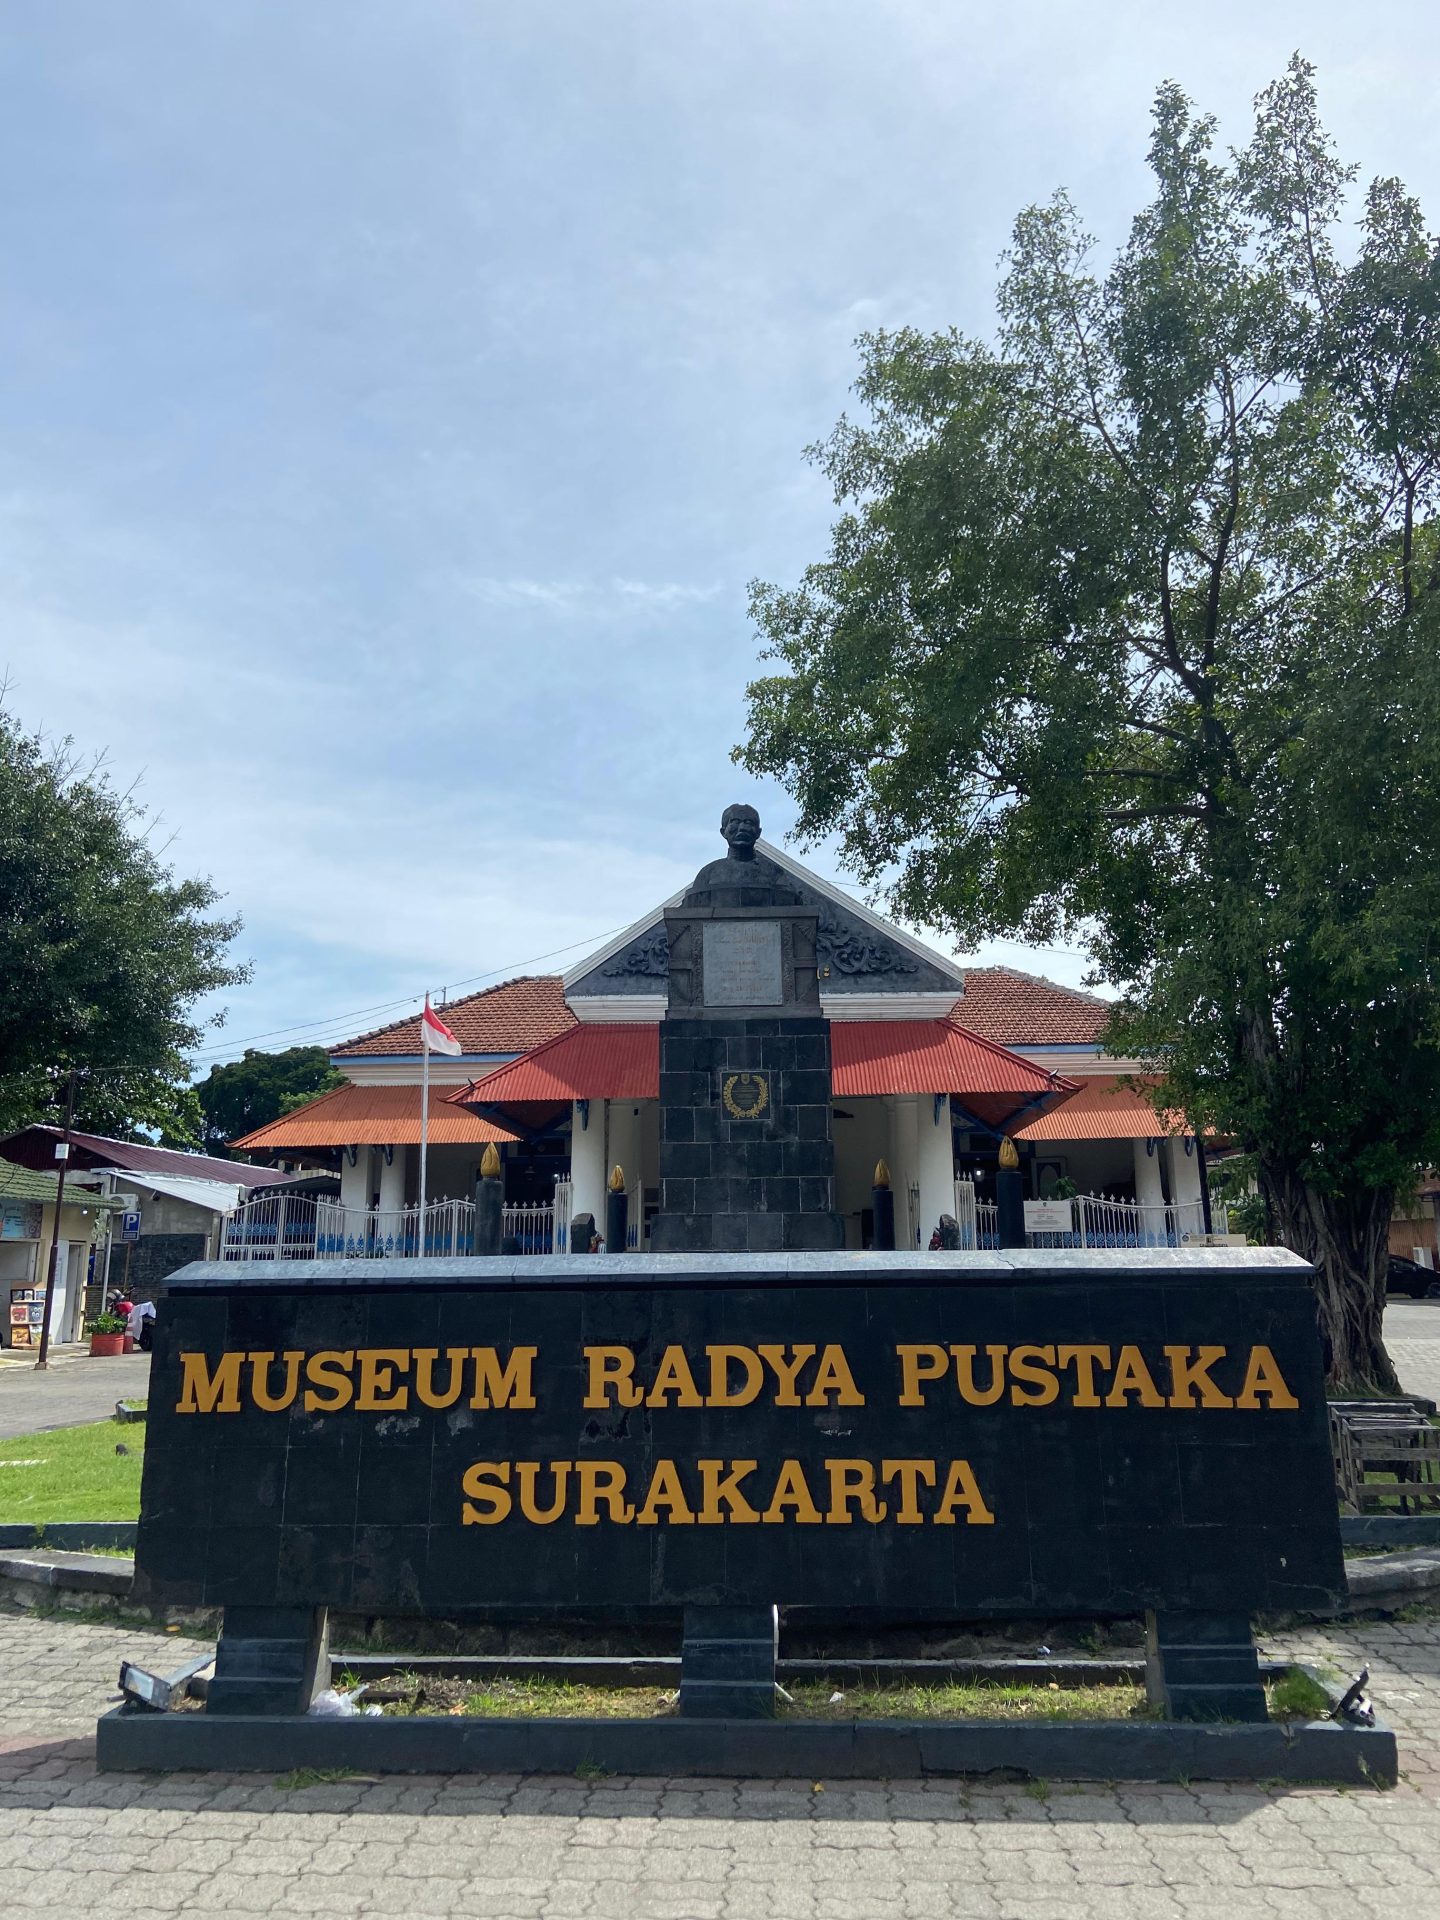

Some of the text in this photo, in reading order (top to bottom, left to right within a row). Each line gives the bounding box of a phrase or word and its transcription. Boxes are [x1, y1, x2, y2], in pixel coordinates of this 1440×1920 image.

[125, 1214, 137, 1230] P
[175, 1344, 1299, 1413] MUSEUM RADYA PUSTAKA
[462, 1459, 995, 1526] SURAKARTA
